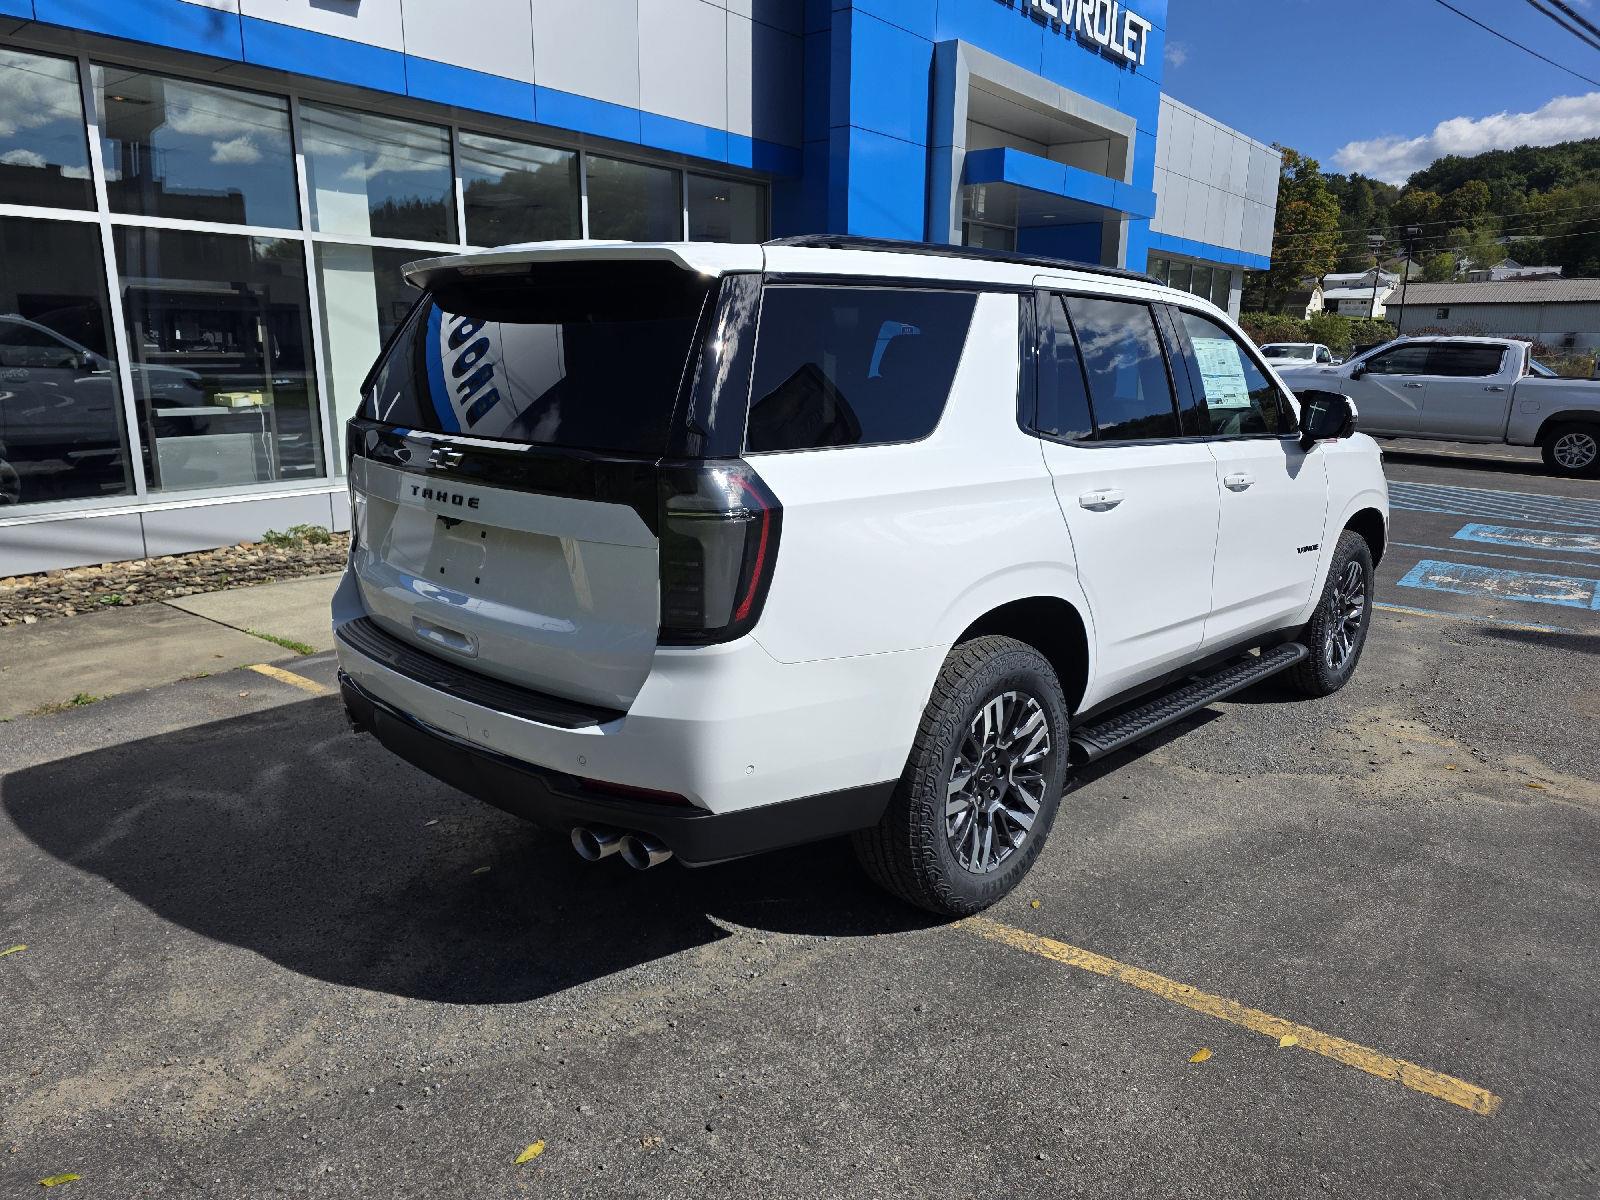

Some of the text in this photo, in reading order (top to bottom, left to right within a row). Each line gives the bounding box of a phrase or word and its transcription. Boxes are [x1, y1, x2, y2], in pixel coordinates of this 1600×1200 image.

[1032, 0, 1152, 66] VROLET
[411, 484, 480, 509] TAHOE
[1296, 543, 1319, 554] TAHOE
